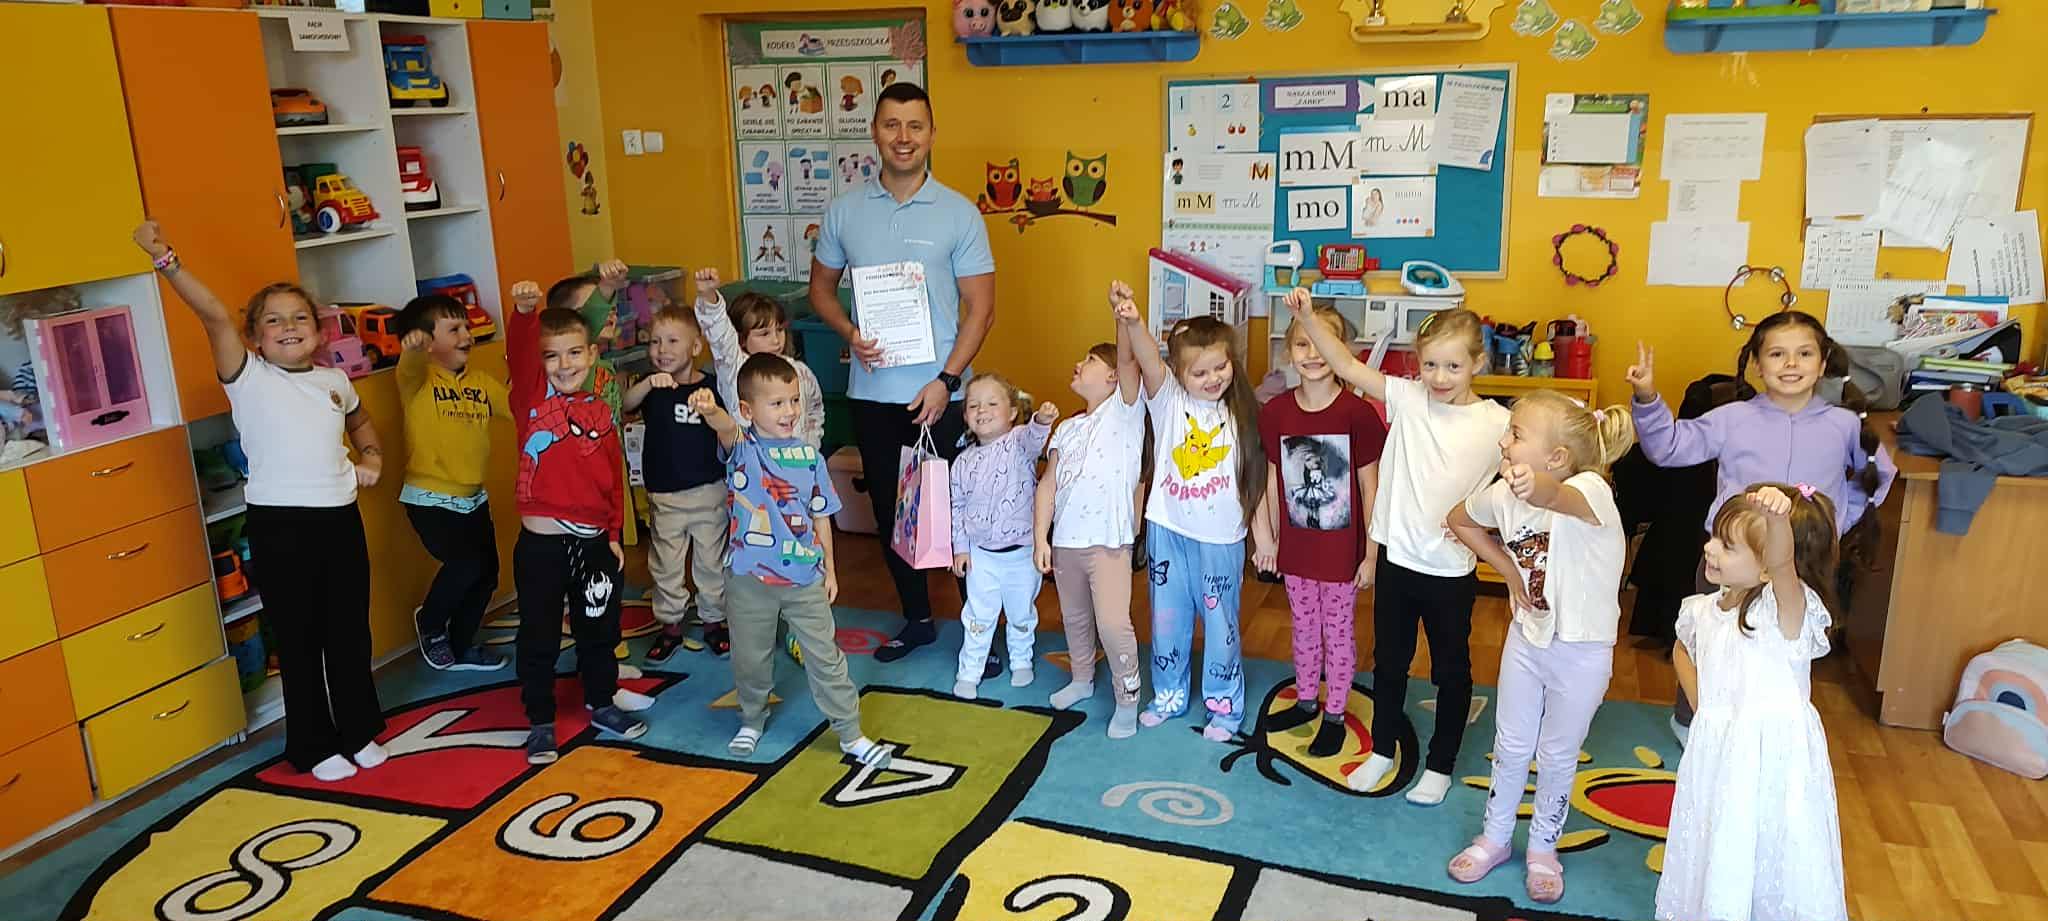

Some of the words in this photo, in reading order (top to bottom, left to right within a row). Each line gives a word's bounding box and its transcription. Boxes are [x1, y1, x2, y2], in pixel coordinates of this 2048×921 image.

[1180, 95, 1184, 110] 1
[1222, 94, 1231, 109] 2
[1383, 88, 1427, 108] ma
[1252, 162, 1269, 181] M
[1296, 200, 1340, 219] mo
[674, 403, 702, 425] 92
[154, 818, 362, 921] 8
